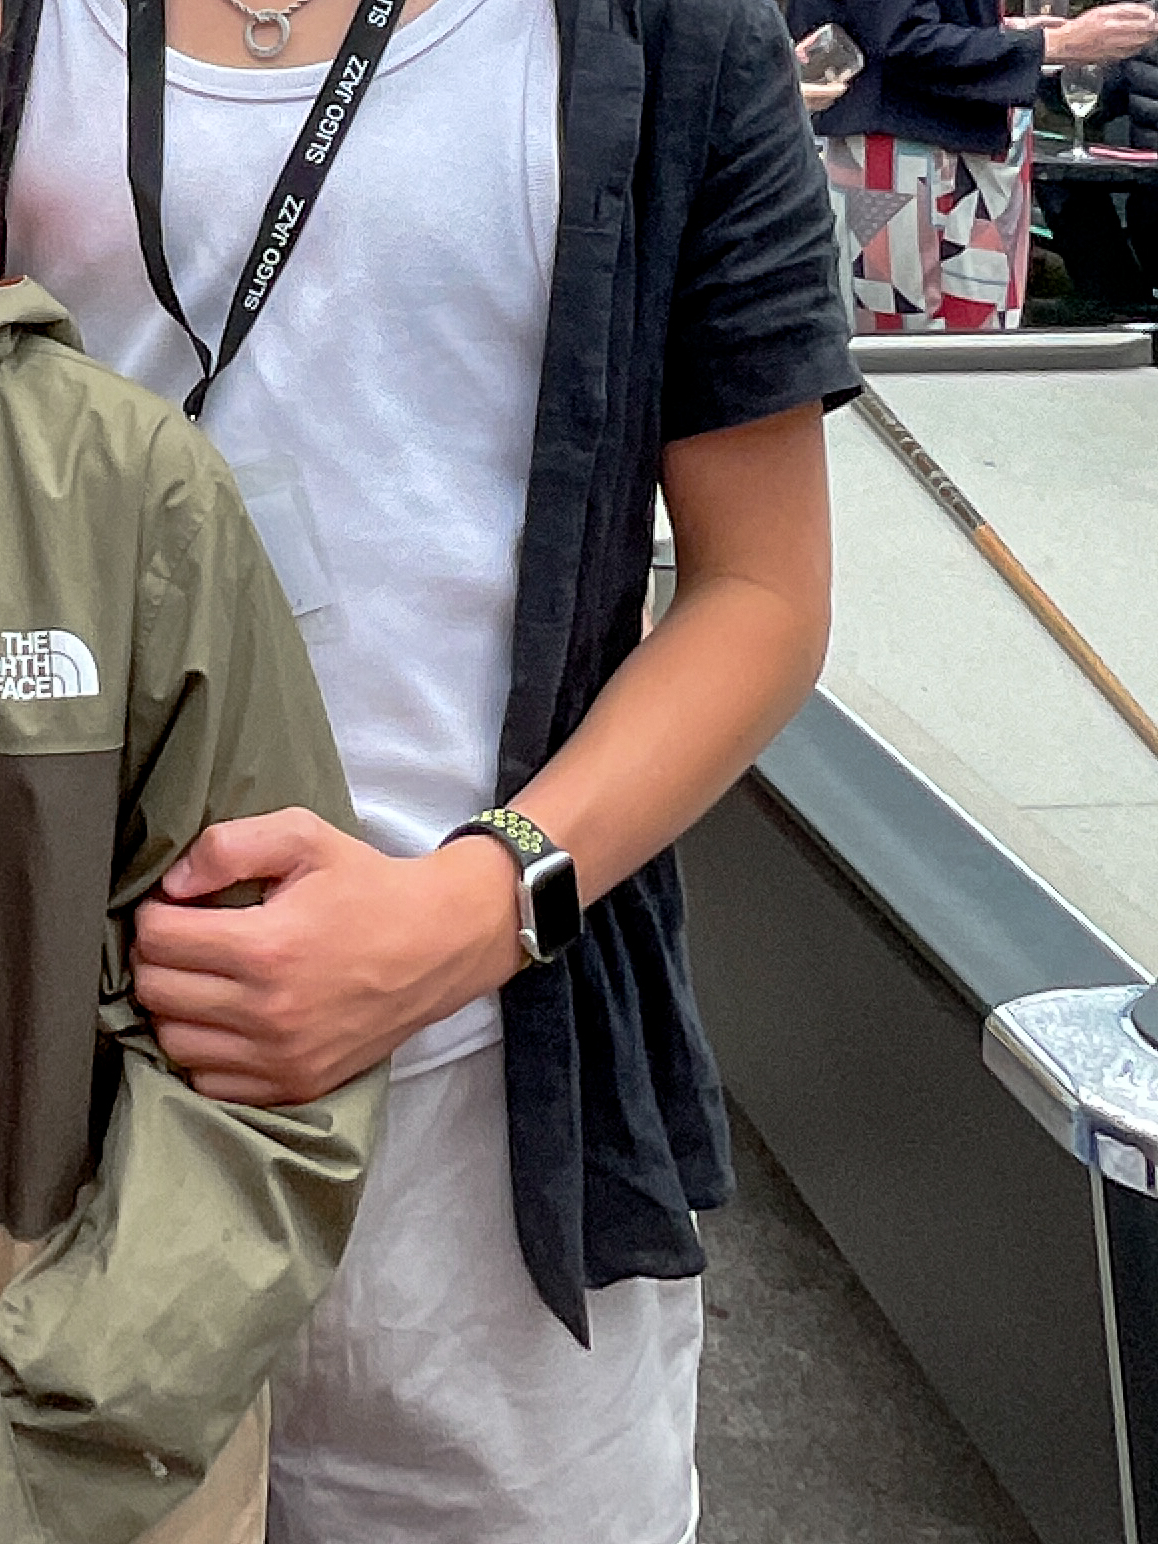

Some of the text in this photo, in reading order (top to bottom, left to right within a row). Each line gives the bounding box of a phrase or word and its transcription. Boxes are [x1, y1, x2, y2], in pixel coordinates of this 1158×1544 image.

[305, 55, 370, 164] SLIGO JAZZ
[244, 195, 305, 310] SLIGO JAZZ
[0, 631, 49, 654] THE
